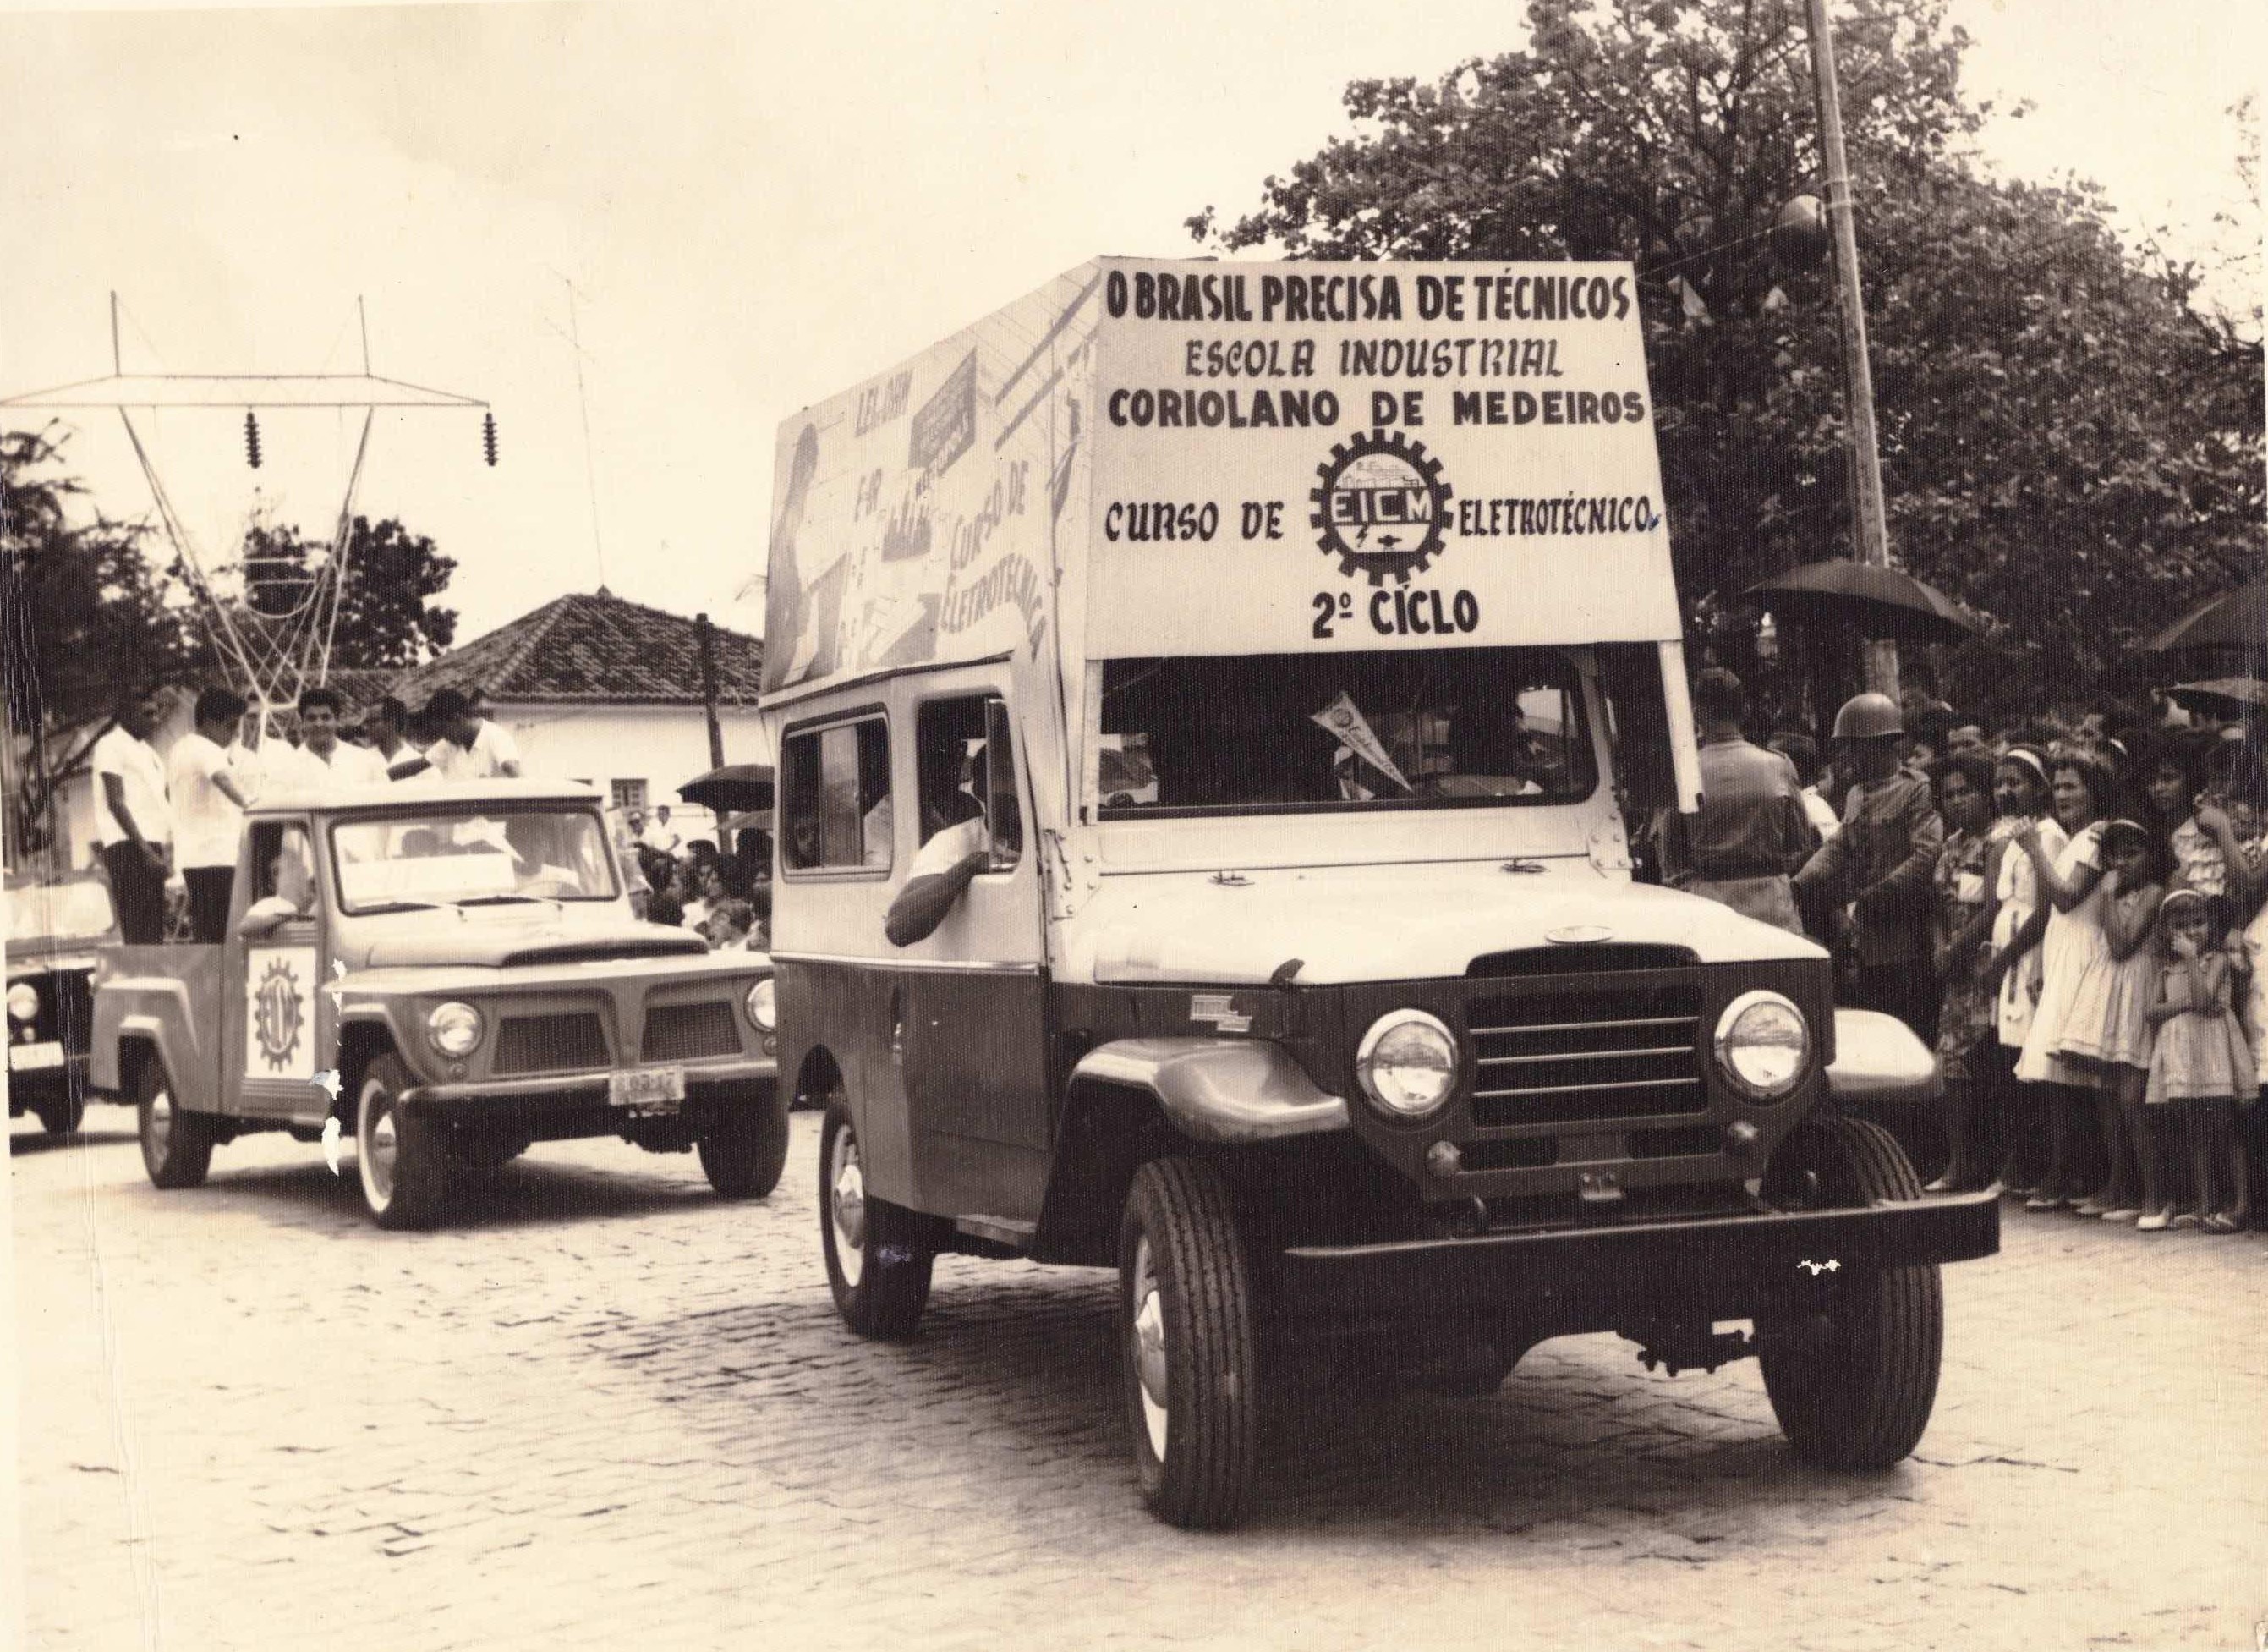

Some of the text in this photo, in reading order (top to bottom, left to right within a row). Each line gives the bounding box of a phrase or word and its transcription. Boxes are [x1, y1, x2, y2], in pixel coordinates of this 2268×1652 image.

[1106, 267, 1630, 322] O BRASIL PRECISA DE TÉCNICOS
[1185, 338, 1563, 378] ESCOLA INDUSTRIAL
[1108, 388, 1645, 428] CORIOLANO DE MEDEIROS
[1104, 501, 1285, 542] CURSO DE
[1329, 488, 1433, 525] EICM
[1312, 592, 1353, 639] 2º
